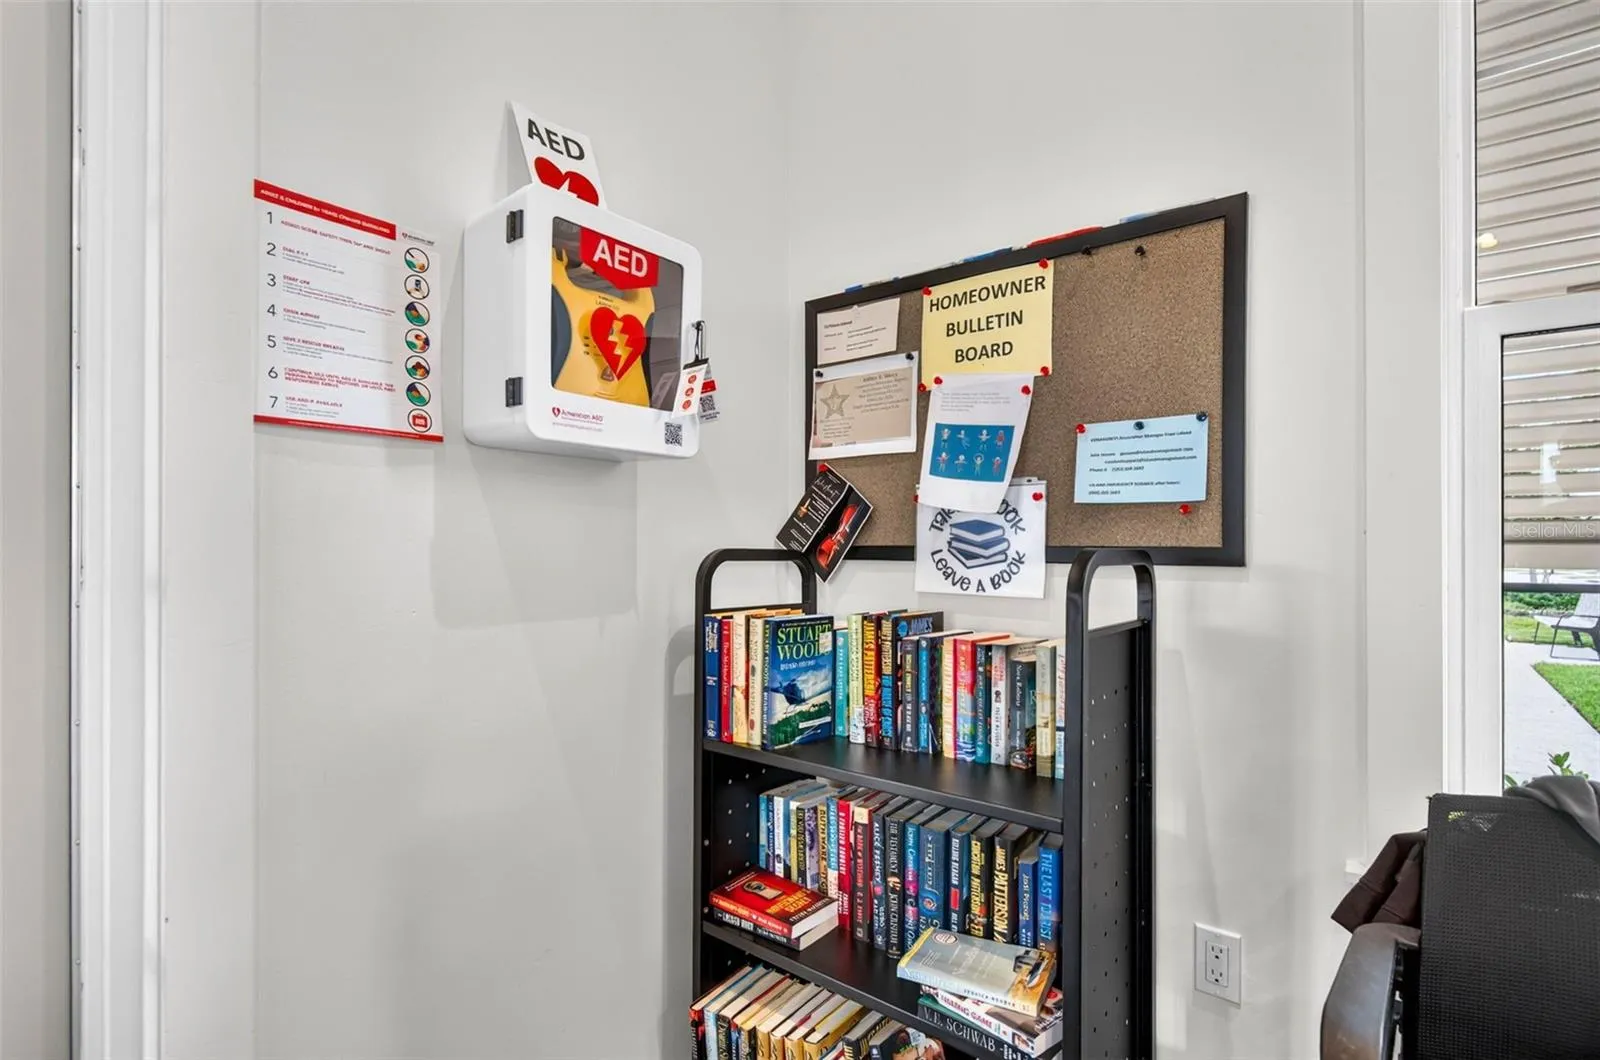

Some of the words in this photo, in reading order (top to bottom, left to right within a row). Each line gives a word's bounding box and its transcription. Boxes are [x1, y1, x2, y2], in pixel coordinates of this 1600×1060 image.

[528, 118, 585, 161] AED
[267, 212, 273, 224] 1
[266, 242, 276, 256] 2
[592, 239, 648, 278] AED
[266, 274, 276, 287] 3
[929, 275, 1046, 313] HOMEOWNER
[267, 304, 277, 317] 4
[946, 310, 1024, 338] BULLETIN
[268, 335, 277, 348] 5
[954, 340, 1014, 363] BOARD
[268, 366, 279, 379] 6
[269, 396, 279, 409] 7
[928, 508, 959, 532] Tak
[931, 549, 971, 592] Leave
[976, 578, 986, 593] A
[864, 620, 875, 653] JAMES
[911, 618, 933, 634] JAMES
[882, 642, 893, 675] PATTERSON
[864, 653, 875, 696] PATTERSON
[1015, 682, 1023, 706] Roberts
[874, 822, 883, 848] ALICE
[890, 836, 898, 873] TESTAMENT
[952, 838, 960, 860] KILLING
[996, 846, 1006, 871] JAMES
[1041, 854, 1053, 875] THE
[971, 876, 981, 914] PATTERSON
[1040, 875, 1052, 901] LAST
[994, 870, 1009, 933] PATTERSON
[890, 912, 898, 944] GRISHAM
[922, 1006, 943, 1027] V.E.
[946, 1018, 996, 1052] SCHWAB
